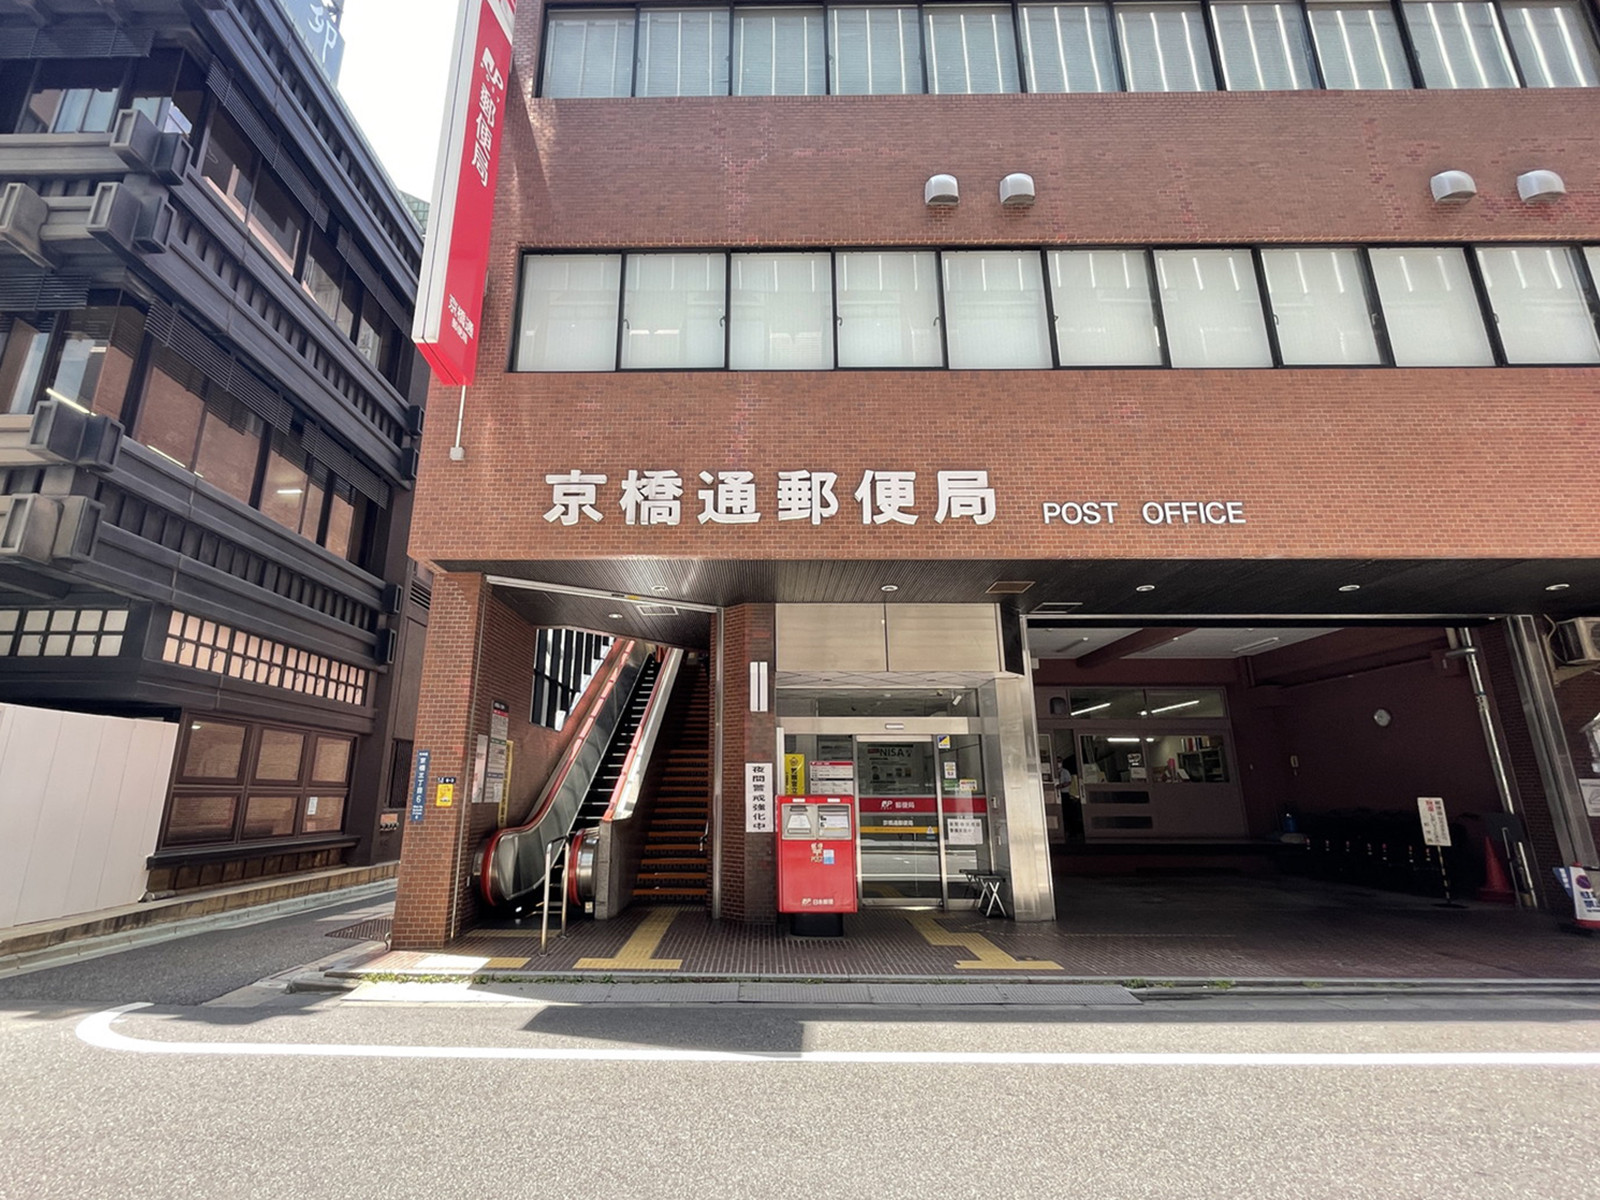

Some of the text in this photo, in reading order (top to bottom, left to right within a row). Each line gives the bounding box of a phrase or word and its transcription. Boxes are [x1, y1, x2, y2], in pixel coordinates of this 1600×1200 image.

[471, 82, 496, 187] 郵便局
[543, 469, 997, 526] 京橋通郵便局
[1042, 501, 1246, 525] POST OFFICE
[880, 748, 905, 757] NISA
